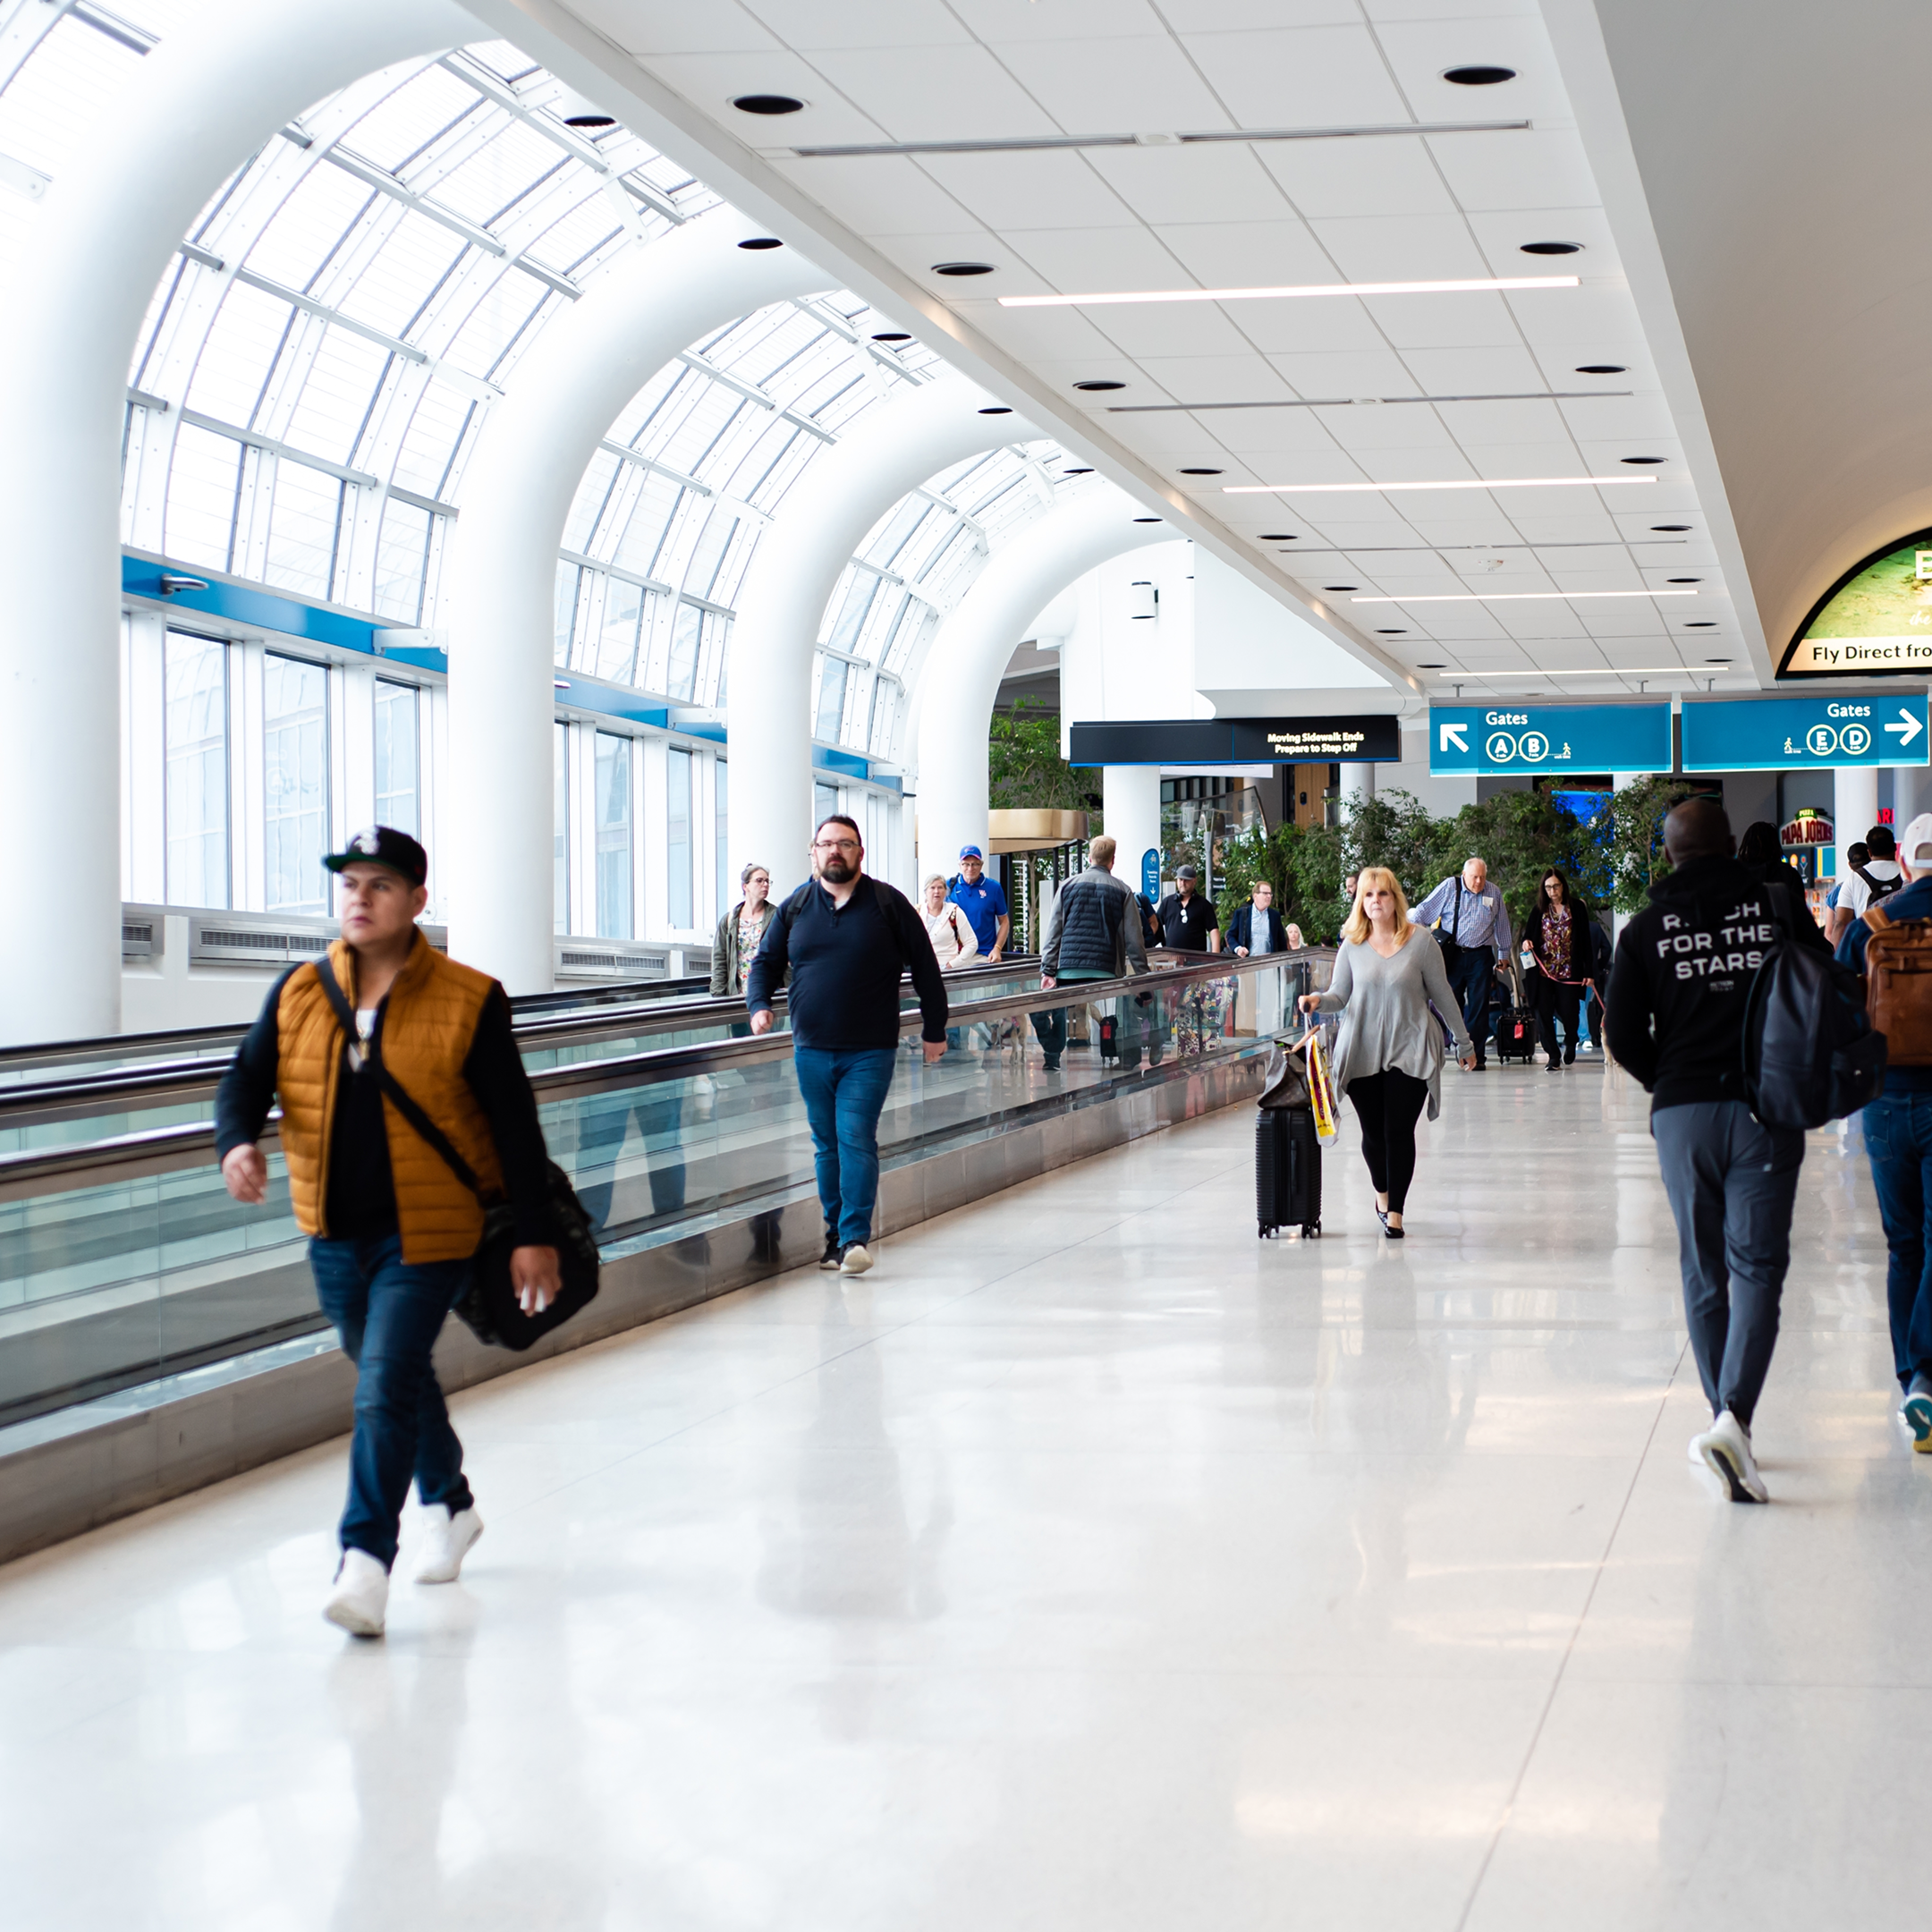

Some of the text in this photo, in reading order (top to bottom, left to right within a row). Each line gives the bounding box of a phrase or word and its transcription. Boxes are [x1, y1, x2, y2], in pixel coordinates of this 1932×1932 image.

[1812, 644, 1932, 664] Fly Direct fro
[1827, 703, 1871, 717] Gates
[1486, 711, 1529, 725] Gates
[1267, 732, 1364, 744] Moving Sidewalk Ends
[1495, 738, 1540, 753] A B
[1816, 730, 1864, 746] E D
[1275, 742, 1358, 755] Prepare to Step Off
[1781, 821, 1804, 845] PAPA
[1657, 924, 1774, 959] FOR THE
[1675, 950, 1763, 979] STARS
